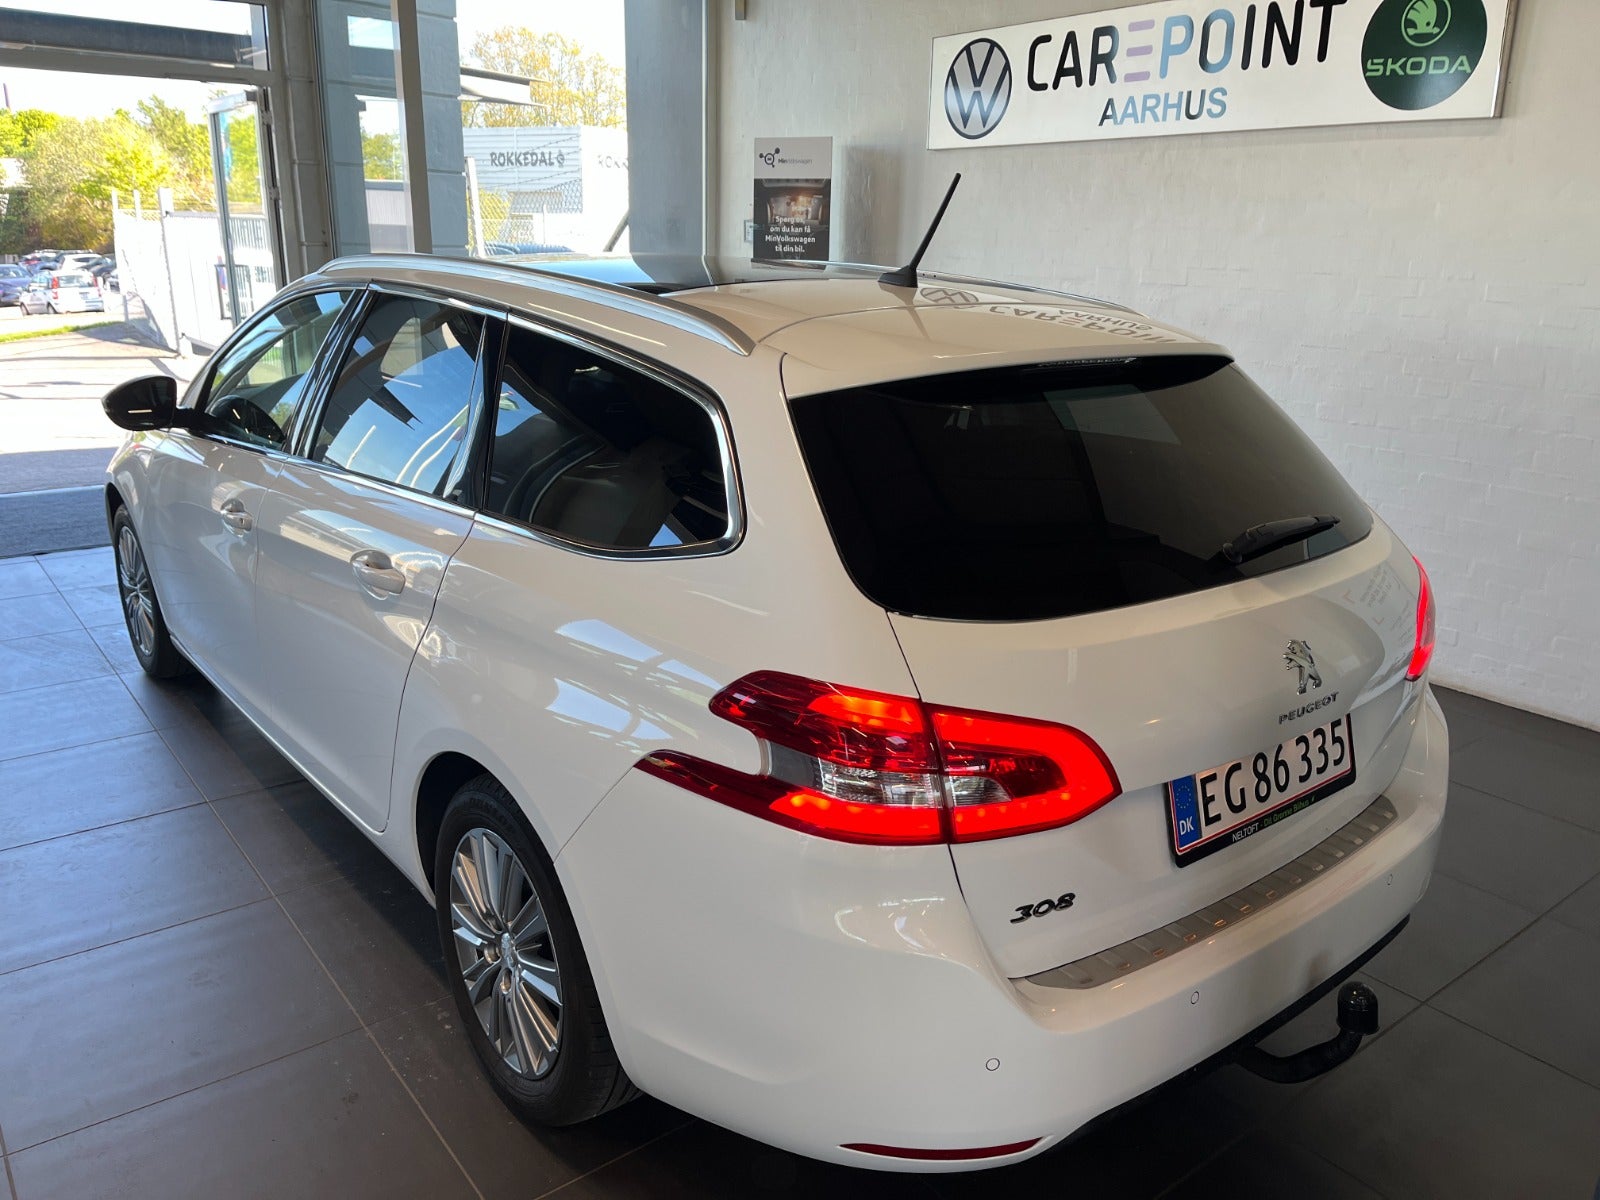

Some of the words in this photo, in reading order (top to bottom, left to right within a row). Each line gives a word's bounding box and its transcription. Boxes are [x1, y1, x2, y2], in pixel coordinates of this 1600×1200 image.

[1027, 0, 1347, 91] CAREPOINT
[1365, 55, 1472, 77] SKODA
[1098, 87, 1228, 126] AARHUS
[765, 234, 816, 244] MinVolkswagen
[804, 225, 811, 233] få
[783, 244, 794, 253] din
[1278, 692, 1339, 725] PEUGEOT
[1199, 762, 1247, 827] EG
[1252, 743, 1290, 803] 86
[1295, 718, 1345, 783] 335
[1179, 815, 1195, 836] DK
[1232, 822, 1259, 843] NELTOFT
[1010, 892, 1076, 924] 308
